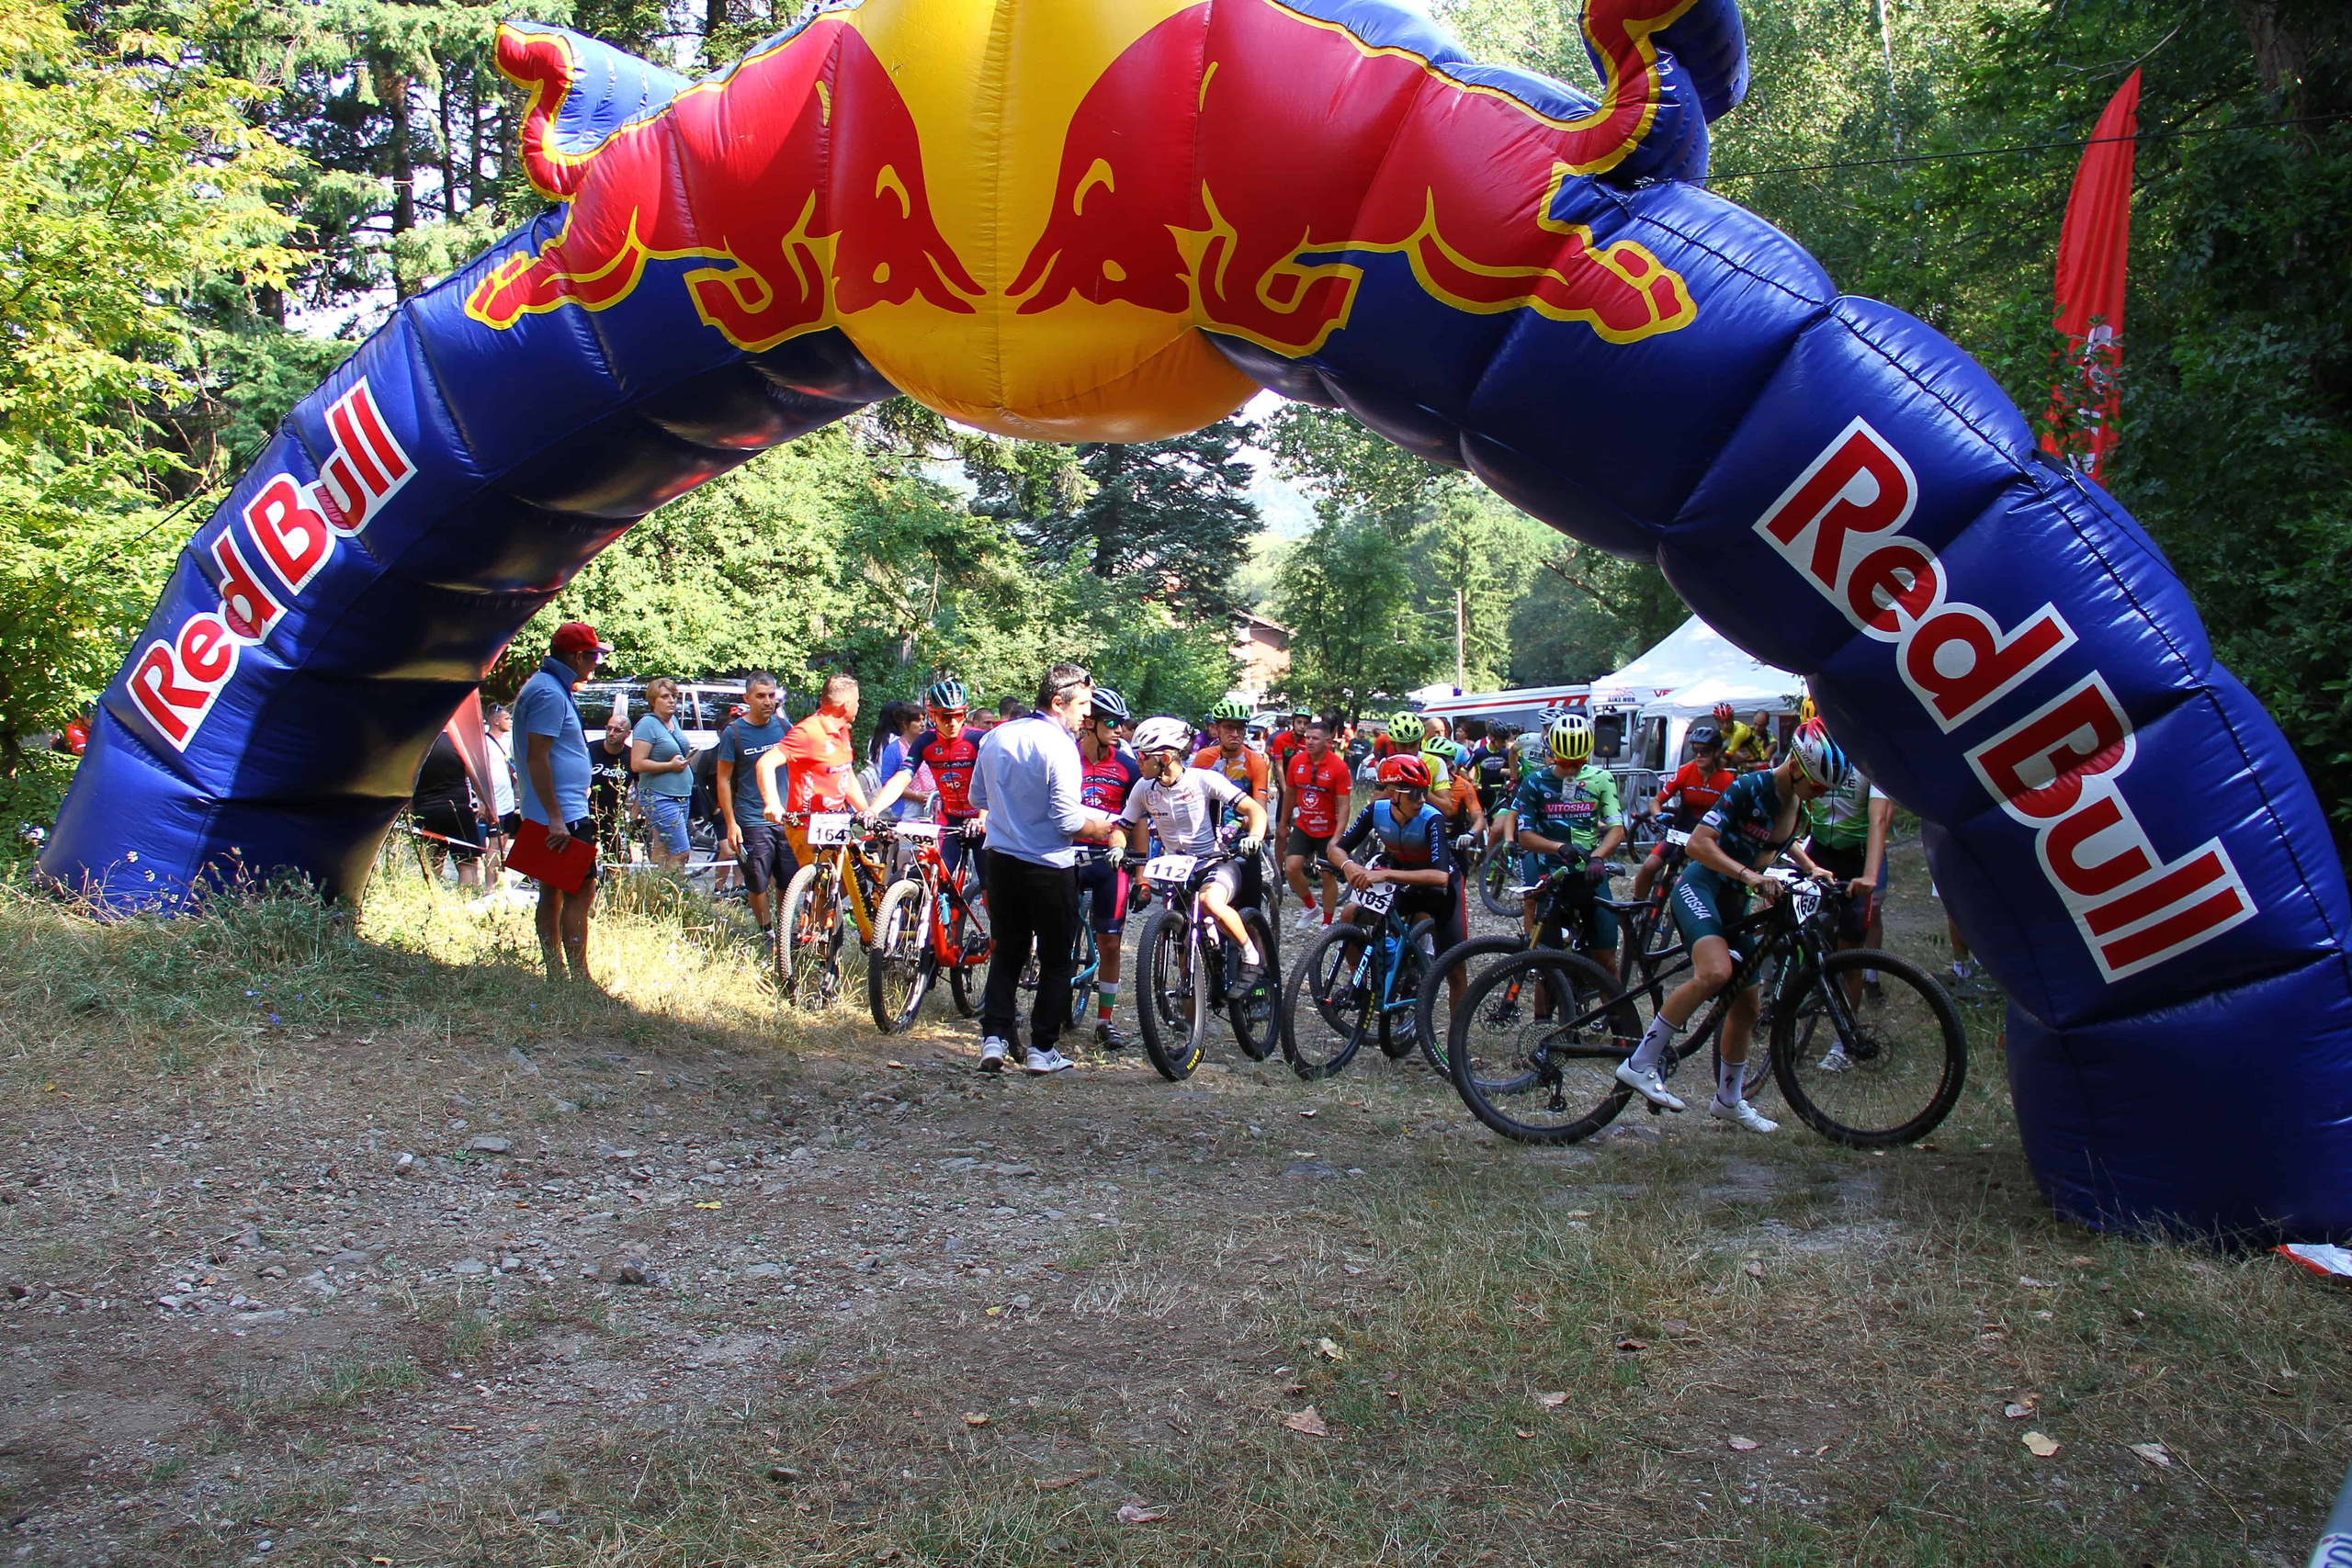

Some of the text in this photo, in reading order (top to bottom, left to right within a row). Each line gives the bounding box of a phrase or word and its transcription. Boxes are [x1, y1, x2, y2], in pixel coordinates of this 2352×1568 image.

[126, 375, 417, 753] Red Bull
[1752, 415, 2258, 984] Red Bull
[1547, 804, 1590, 812] VITOSHA
[816, 828, 845, 841] 164
[1152, 863, 1187, 879] 112
[1679, 883, 1712, 919] VITOSHA
[1795, 897, 1817, 919] 168
